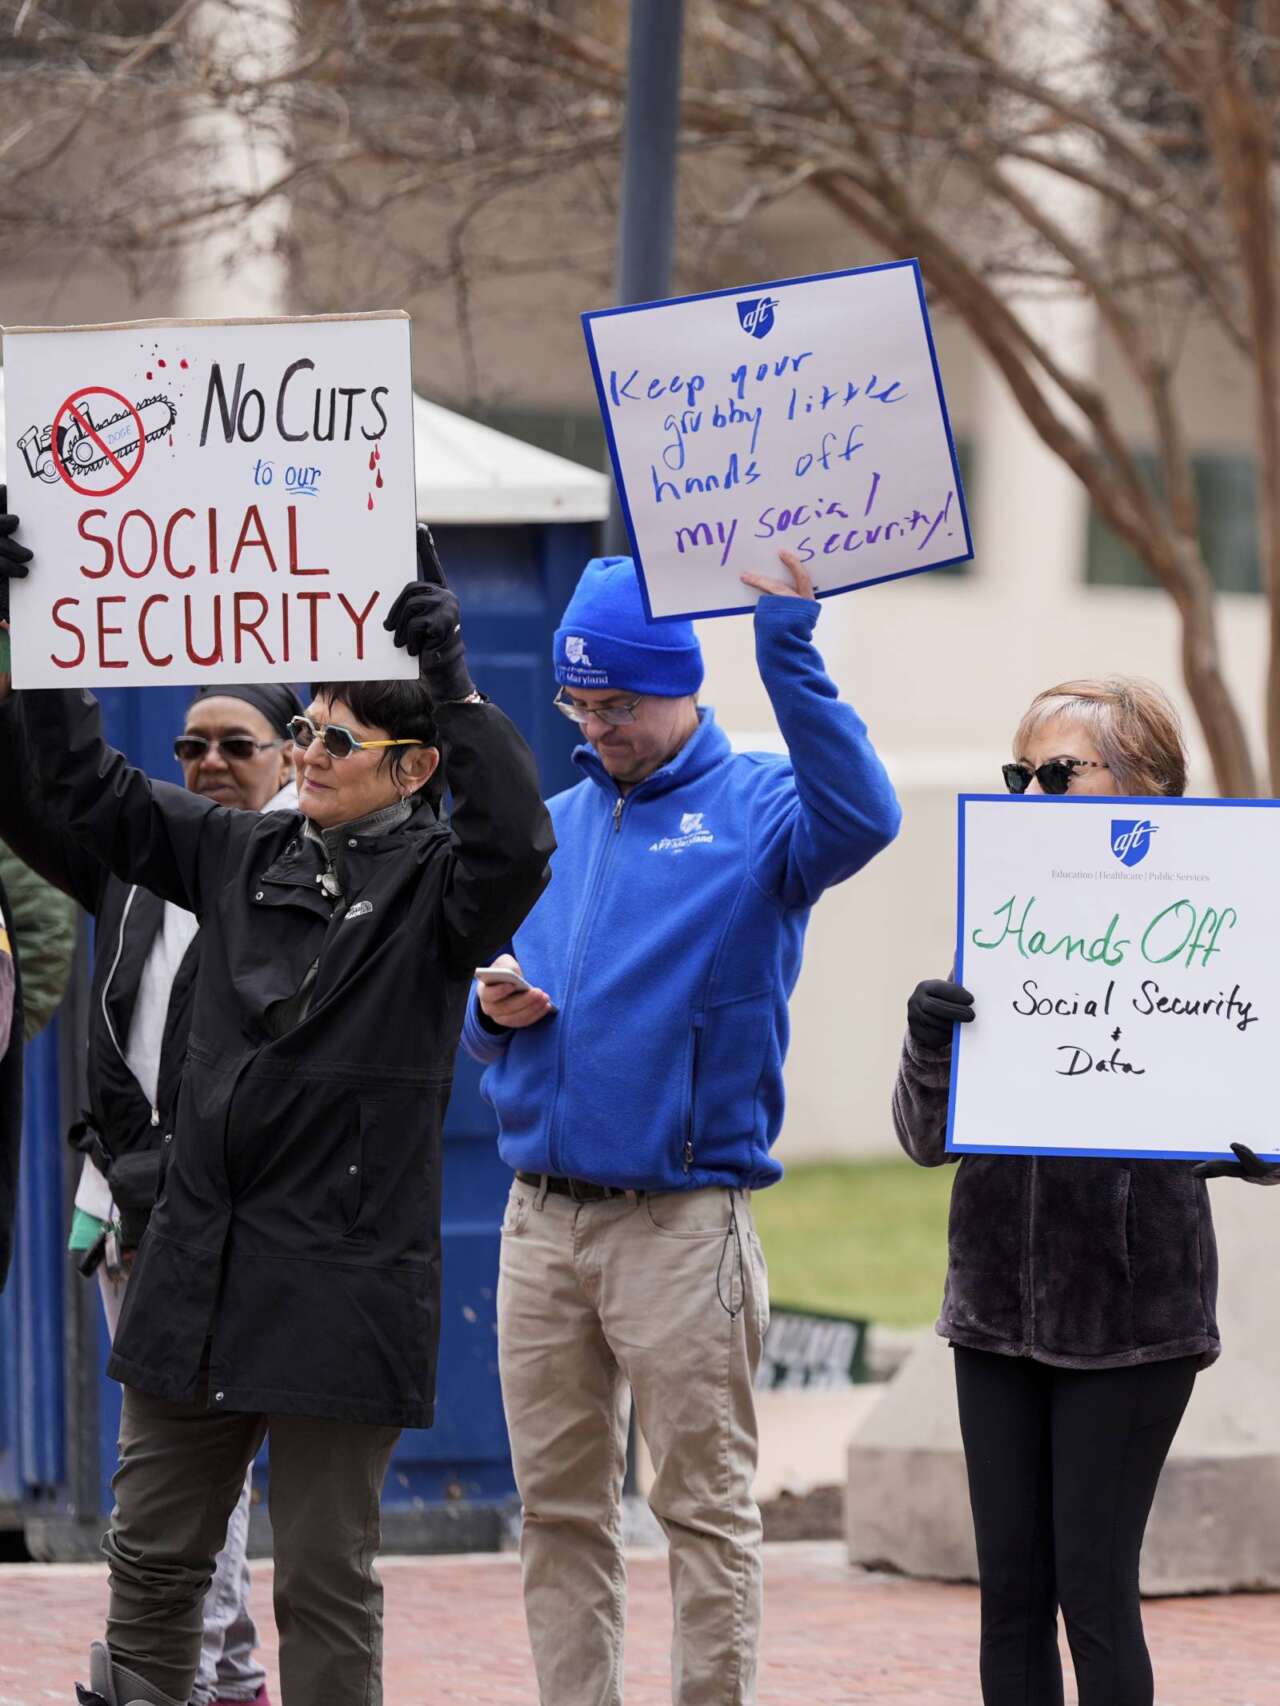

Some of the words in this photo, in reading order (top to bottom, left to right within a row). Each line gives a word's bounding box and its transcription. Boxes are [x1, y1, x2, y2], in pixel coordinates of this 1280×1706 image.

[609, 370, 705, 408] Keep
[731, 352, 813, 400] your
[663, 398, 763, 471] grubby
[788, 375, 909, 421] little
[253, 459, 274, 486] to
[285, 466, 322, 489] our
[652, 453, 761, 504] hands
[795, 424, 865, 477] off
[78, 504, 330, 579] SOCIAL
[674, 519, 738, 567] my
[755, 473, 881, 539] social
[50, 591, 381, 668] SECURITY
[1113, 818, 1160, 860] aft
[1051, 869, 1094, 880] Education
[1100, 869, 1145, 881] Healthcare
[1149, 870, 1174, 881] Public
[1176, 872, 1211, 882] Services
[972, 896, 1131, 967] Hands
[1141, 898, 1238, 969] Off
[1013, 980, 1115, 1017] Social
[1133, 980, 1259, 1032] Security
[1056, 1045, 1146, 1077] Data
